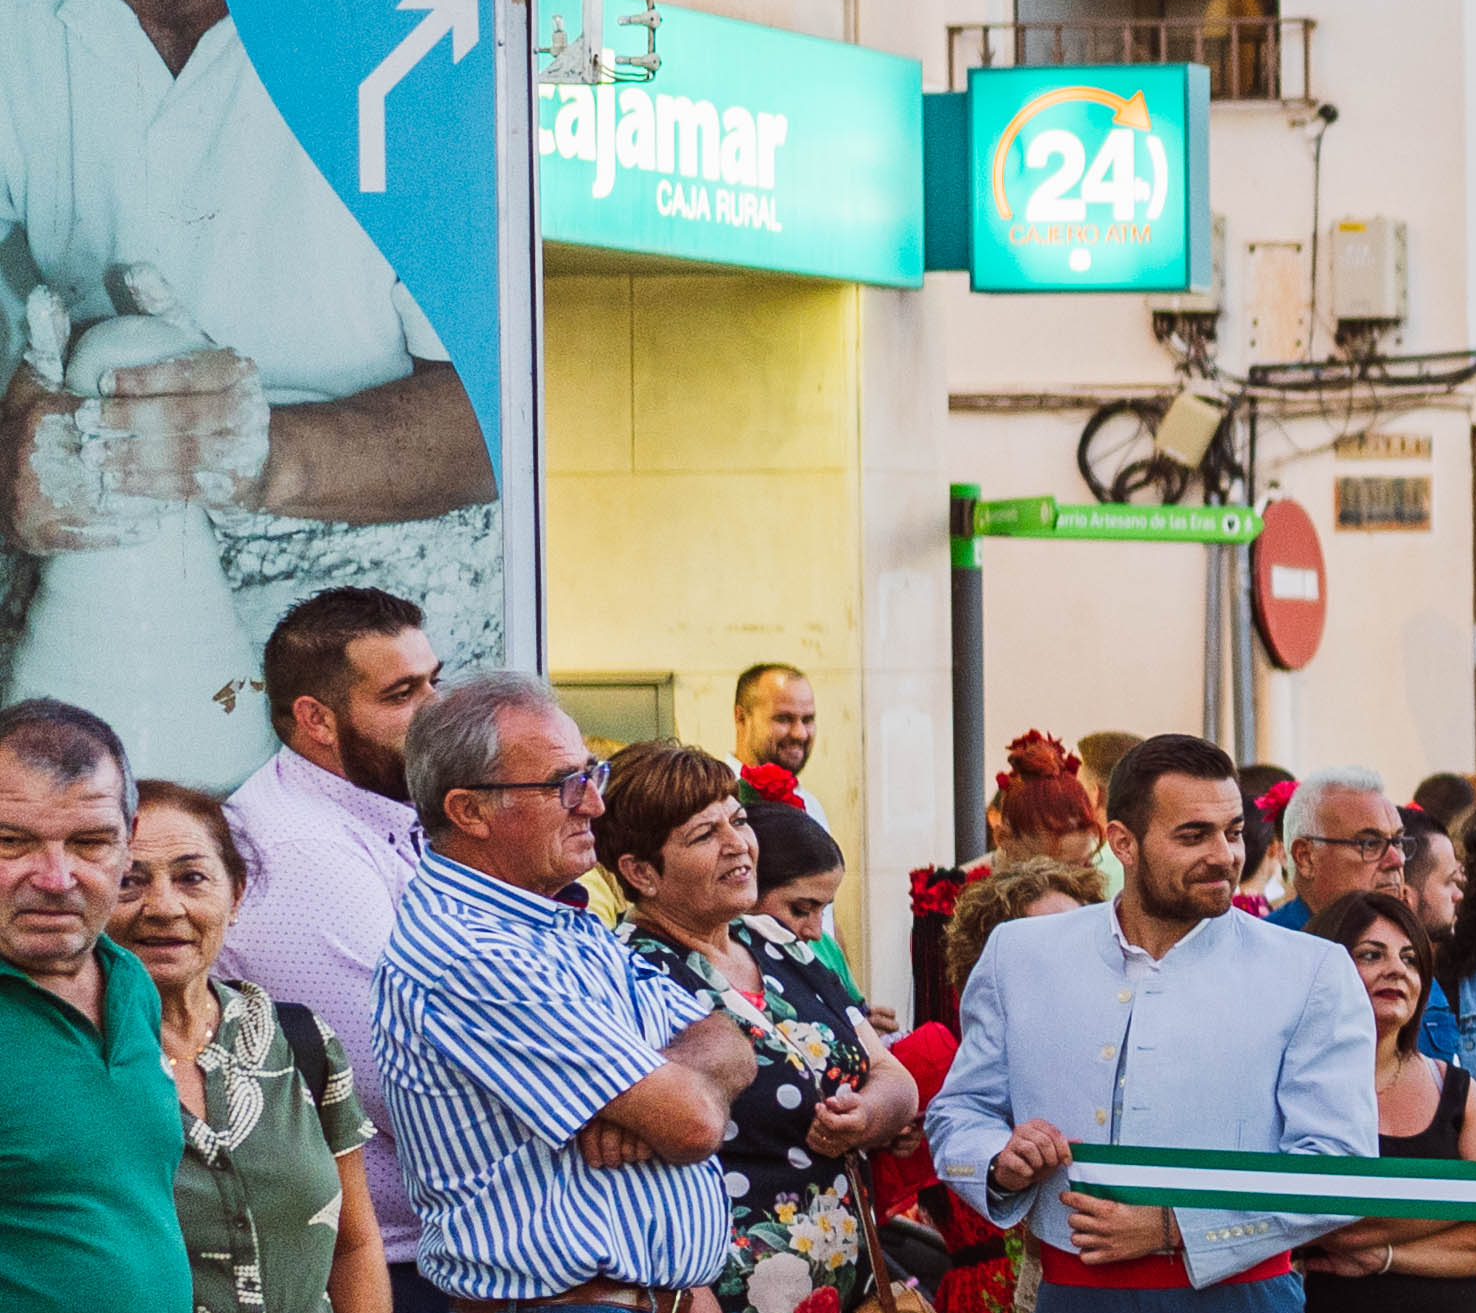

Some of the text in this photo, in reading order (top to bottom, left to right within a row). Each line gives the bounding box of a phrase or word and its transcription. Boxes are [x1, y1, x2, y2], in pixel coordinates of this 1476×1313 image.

[656, 179, 783, 233] CAJA RURAL
[1009, 223, 1152, 245] CAJERO ATM
[1057, 511, 1087, 528] arrio
